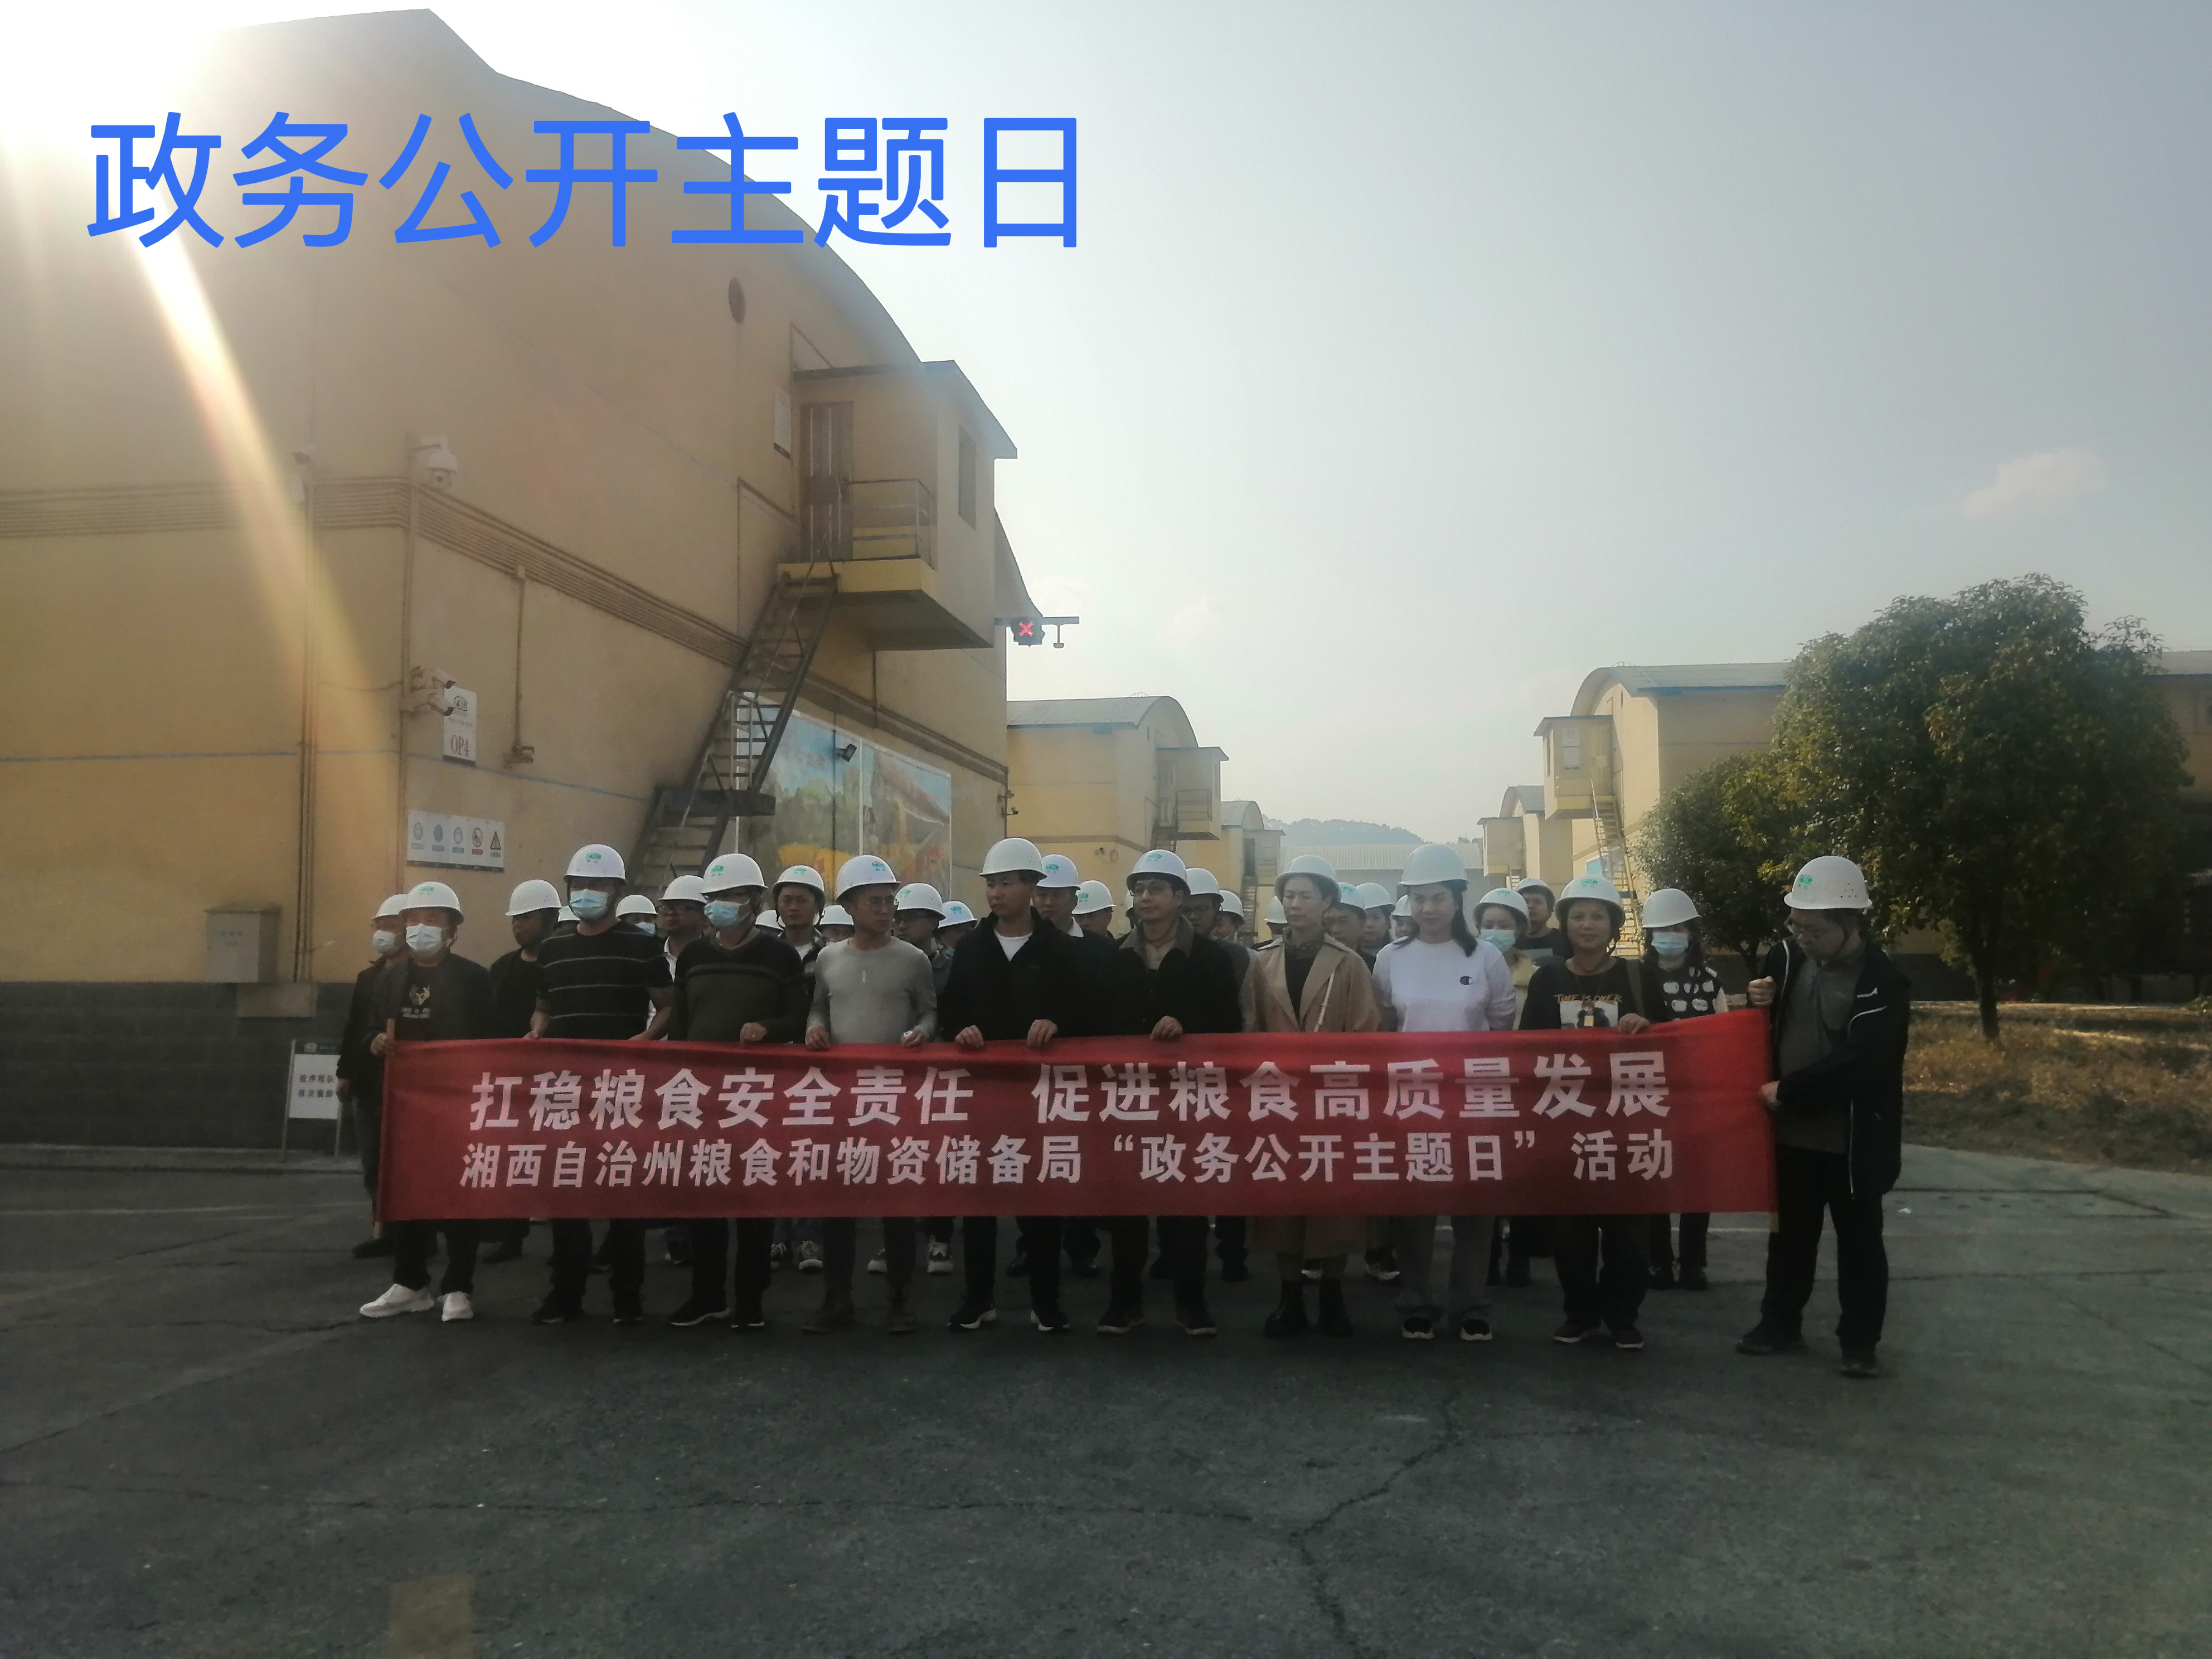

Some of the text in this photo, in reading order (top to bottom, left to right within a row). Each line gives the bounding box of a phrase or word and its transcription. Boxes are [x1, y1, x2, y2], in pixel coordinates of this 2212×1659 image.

[470, 1051, 1671, 1131] 扛稳粮食安全责任 促进粮食高质量发展
